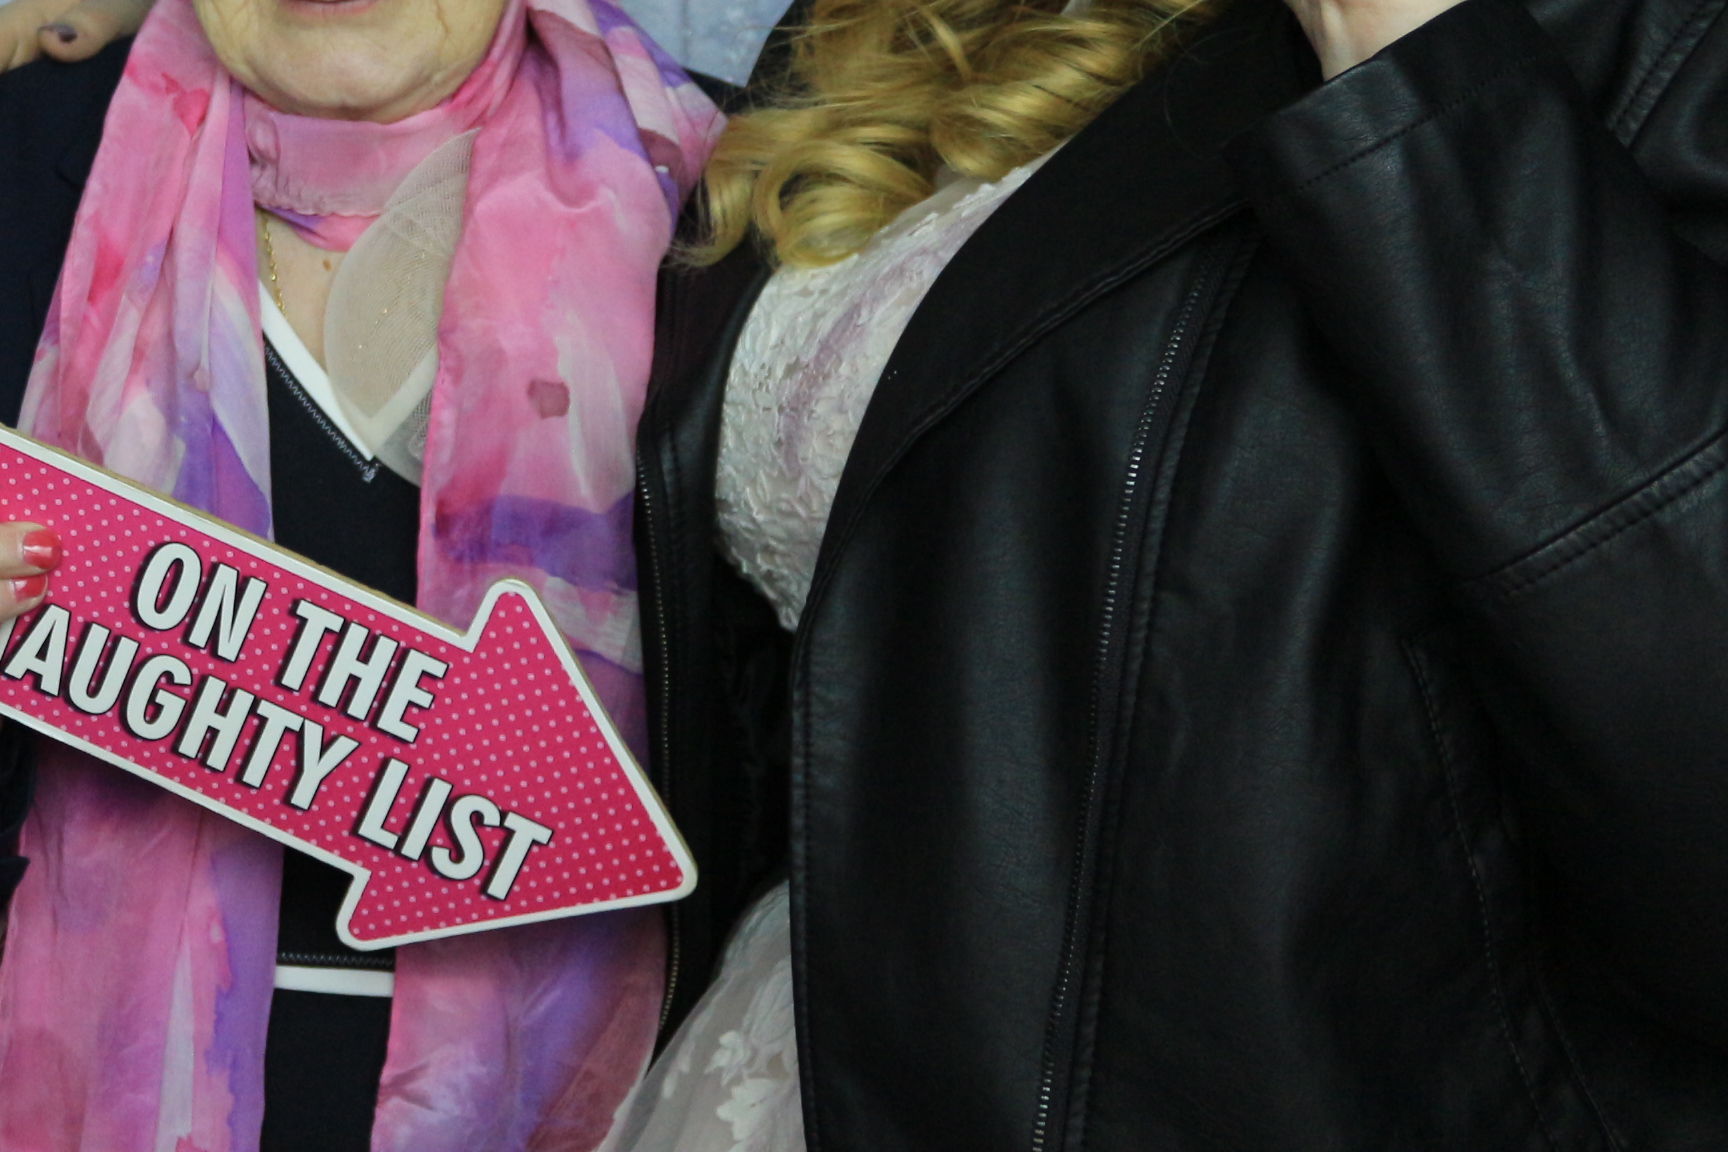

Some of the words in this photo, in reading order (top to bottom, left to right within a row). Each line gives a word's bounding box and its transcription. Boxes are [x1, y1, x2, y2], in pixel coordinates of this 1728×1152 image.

[136, 541, 268, 662] ON
[275, 598, 449, 744] THE
[357, 760, 554, 901] LIST
